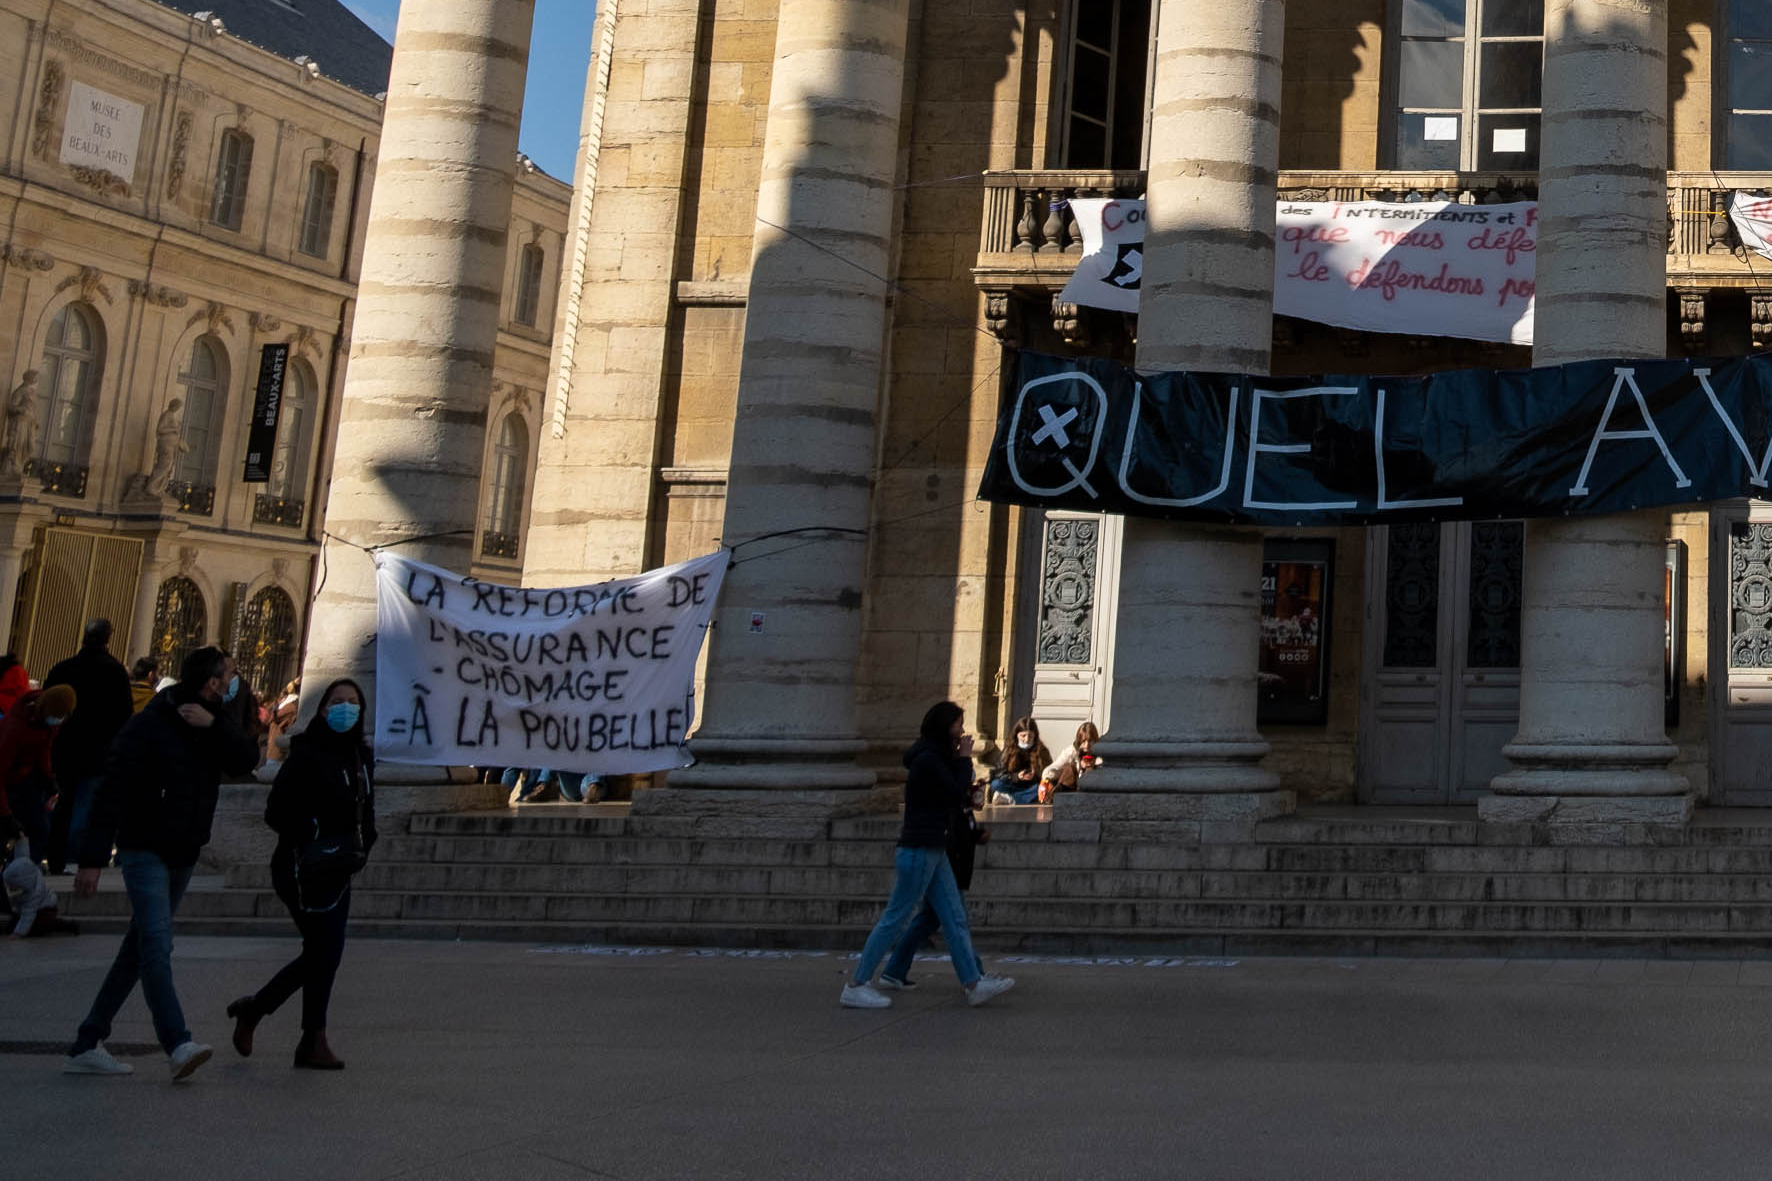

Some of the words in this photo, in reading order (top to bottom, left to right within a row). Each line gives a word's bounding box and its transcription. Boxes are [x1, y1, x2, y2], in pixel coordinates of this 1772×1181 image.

[69, 136, 128, 165] BEAUX-ARTS
[93, 123, 112, 139] DES
[1281, 205, 1313, 216] des
[1496, 211, 1515, 225] et
[1282, 224, 1351, 253] que
[1375, 229, 1445, 250] nous
[1287, 251, 1330, 281] le
[1345, 258, 1485, 301] défendons
[265, 348, 286, 426] BEAUX-ARTS
[1006, 371, 1464, 510] QUEL
[407, 570, 446, 610] LA
[667, 573, 710, 608] DE
[430, 618, 676, 664] L'ASSURANCE
[456, 657, 629, 702] CHÔMAGE
[457, 696, 499, 747] LA
[520, 708, 686, 752] POUBELLE
